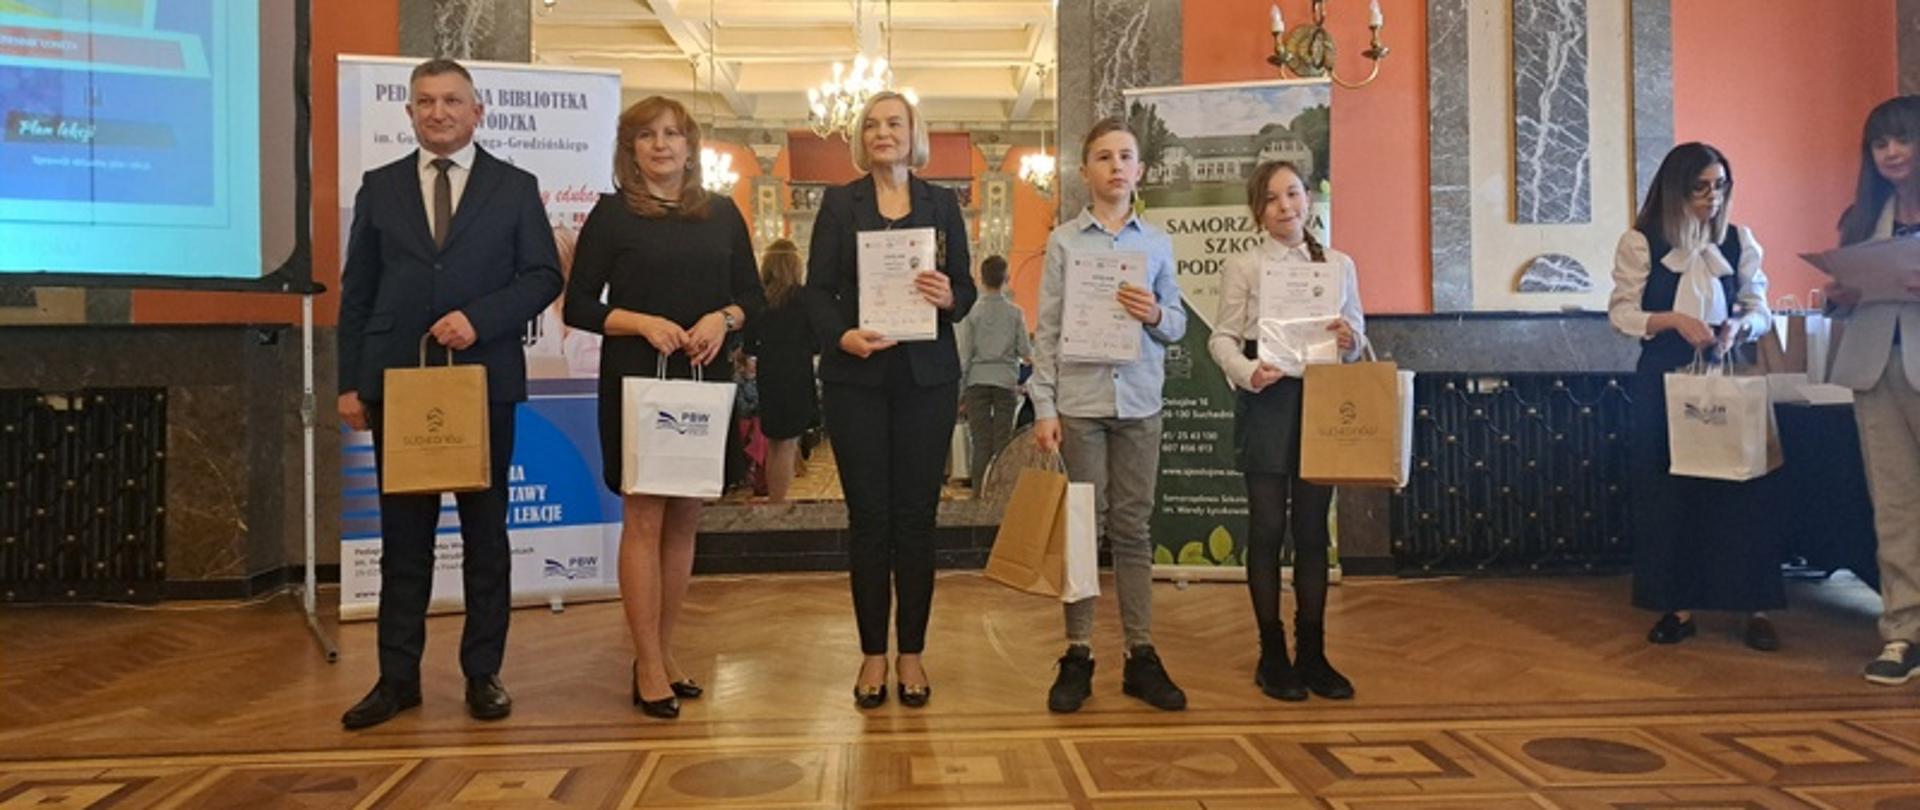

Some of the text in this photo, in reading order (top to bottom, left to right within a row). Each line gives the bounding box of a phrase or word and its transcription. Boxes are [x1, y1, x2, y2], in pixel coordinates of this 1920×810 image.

[498, 89, 588, 110] BIBLIOTEKA
[19, 120, 53, 136] Plan
[374, 132, 393, 144] im.
[681, 411, 710, 422] PBW
[509, 484, 547, 502] TAWY
[513, 504, 563, 525] LEKCJE
[568, 557, 597, 567] PBW
